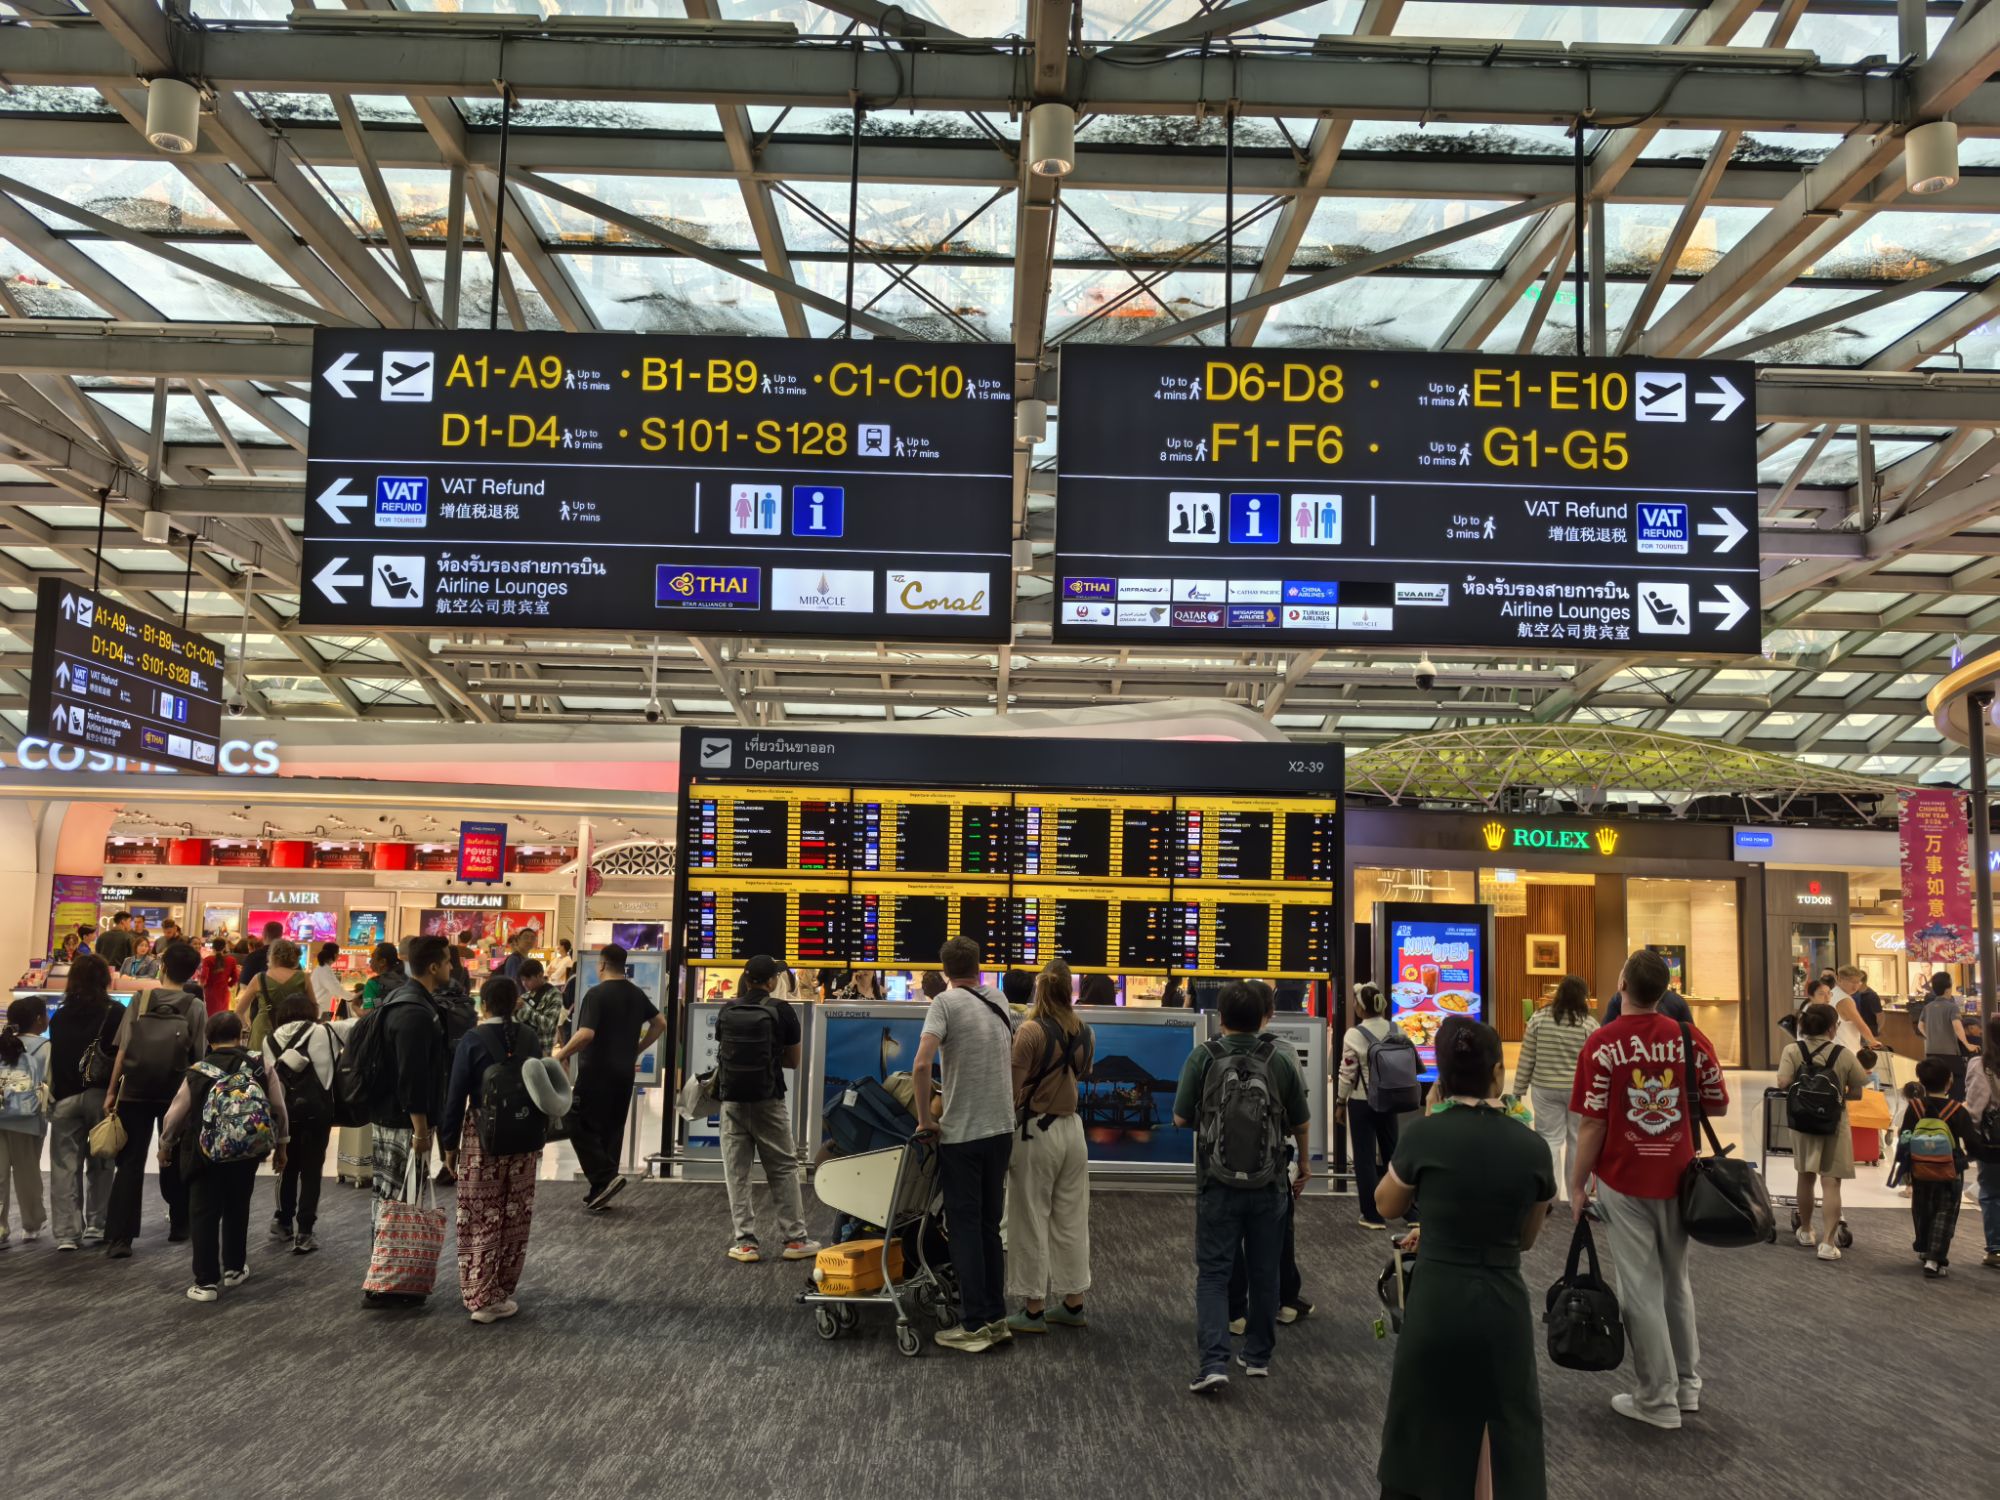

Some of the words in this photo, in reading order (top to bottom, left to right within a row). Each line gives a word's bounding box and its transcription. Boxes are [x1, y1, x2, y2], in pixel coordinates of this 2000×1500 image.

[445, 354, 563, 389] A1-A9
[577, 370, 589, 380] Up
[591, 370, 601, 379] to
[641, 357, 758, 394] B1-B9
[774, 373, 786, 385] Up
[788, 374, 797, 383] to
[829, 362, 964, 399] C1-C10
[978, 379, 990, 390] Up
[991, 379, 1001, 388] to
[1161, 376, 1174, 388] Up
[1177, 377, 1188, 386] to
[1206, 361, 1344, 403] D6-D8
[577, 381, 587, 390] 15
[589, 382, 610, 391] mins
[774, 386, 785, 395] 13
[787, 387, 807, 396] mins
[1429, 382, 1442, 394] Up
[1445, 383, 1455, 393] to
[1473, 368, 1628, 411] E1-E10
[978, 391, 989, 399] 15
[990, 391, 1011, 400] mins
[1154, 391, 1161, 400] 4
[1163, 391, 1188, 400] mins
[1418, 397, 1429, 406] 11
[1432, 397, 1455, 407] mins
[441, 413, 561, 448] D1-D4
[575, 428, 587, 440] Up
[589, 429, 598, 438] to
[640, 415, 848, 456] S101-S128
[582, 441, 603, 450] mins
[907, 437, 919, 449] Up
[920, 438, 930, 447] to
[1167, 438, 1180, 450] Up
[1183, 439, 1193, 448] to
[1211, 423, 1344, 464] F1-F6
[1430, 442, 1443, 454] Up
[1446, 443, 1456, 452] to
[1483, 427, 1629, 470] G1-G5
[907, 450, 917, 458] 17
[919, 450, 940, 459] mins
[1160, 452, 1167, 461] 8
[1169, 452, 1193, 461] mins
[1418, 456, 1430, 466] 10
[1433, 456, 1457, 466] mins
[383, 481, 423, 501] VAT
[441, 478, 476, 495] VAT
[482, 479, 545, 496] Refund
[381, 502, 422, 512] REFUND
[440, 503, 520, 520] 增值税退税
[572, 501, 584, 512] Up
[586, 502, 596, 510] to
[1525, 501, 1560, 517] VAT
[1566, 502, 1628, 519] Refund
[572, 513, 578, 521] 7
[580, 513, 601, 522] mins
[1453, 515, 1466, 526] Up
[1470, 516, 1480, 526] to
[1643, 508, 1682, 527] VAT
[1446, 529, 1453, 538] 3
[1456, 529, 1480, 539] mins
[1548, 526, 1628, 543] 增值税退税
[1643, 528, 1683, 539] REFUND
[437, 553, 607, 575] ห้องรับรองสายการบิน
[436, 577, 490, 594] Airline
[495, 578, 568, 598] Lounges
[696, 577, 748, 594] THAI
[1083, 583, 1110, 593] THAI
[1462, 575, 1630, 599] ห้องรับรองสายการบิน
[799, 596, 846, 607] MIRACLE
[900, 581, 985, 612] Coral
[436, 599, 550, 616] 航空公司贵宾室
[1500, 602, 1553, 618] Airline
[1559, 603, 1631, 623] Lounges
[94, 606, 126, 632] A1-A9
[1174, 610, 1207, 620] QATAR
[144, 623, 172, 650] B1-B9
[1517, 623, 1630, 640] 航空公司贵宾室
[91, 634, 123, 662] D1-D4
[185, 641, 215, 666] C1-C10
[74, 667, 87, 680] VAT
[142, 653, 189, 685] S101-S128
[151, 734, 164, 745] THAI
[745, 738, 835, 756] เที่ยวบินขาออก
[744, 758, 820, 773] Departures
[1288, 760, 1324, 773] X2-39
[1513, 827, 1590, 849] ROLEX
[465, 847, 498, 856] POWER
[470, 855, 492, 864] PASS
[1924, 835, 1945, 917] 万事如意
[268, 891, 287, 903] LA
[289, 892, 320, 904] MER
[441, 895, 502, 907] GUERLAIN
[1797, 896, 1832, 905] TUDOR
[1404, 935, 1436, 956] NOW
[1432, 941, 1469, 962] OPEN
